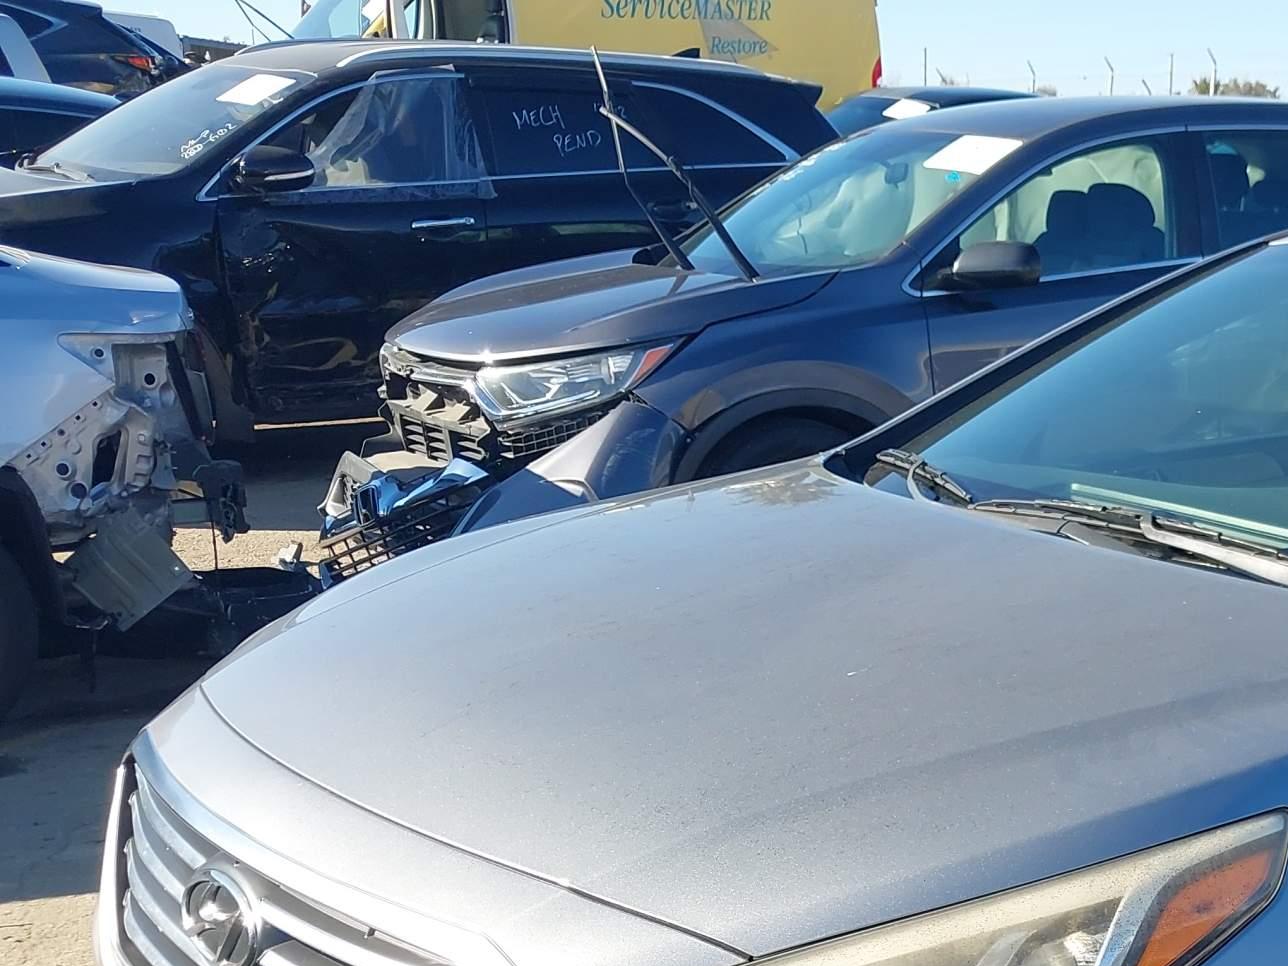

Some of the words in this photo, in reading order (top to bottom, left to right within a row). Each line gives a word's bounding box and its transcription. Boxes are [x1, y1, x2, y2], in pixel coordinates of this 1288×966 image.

[710, 36, 768, 55] Restore
[512, 104, 565, 130] MECH
[553, 130, 601, 157] PEND
